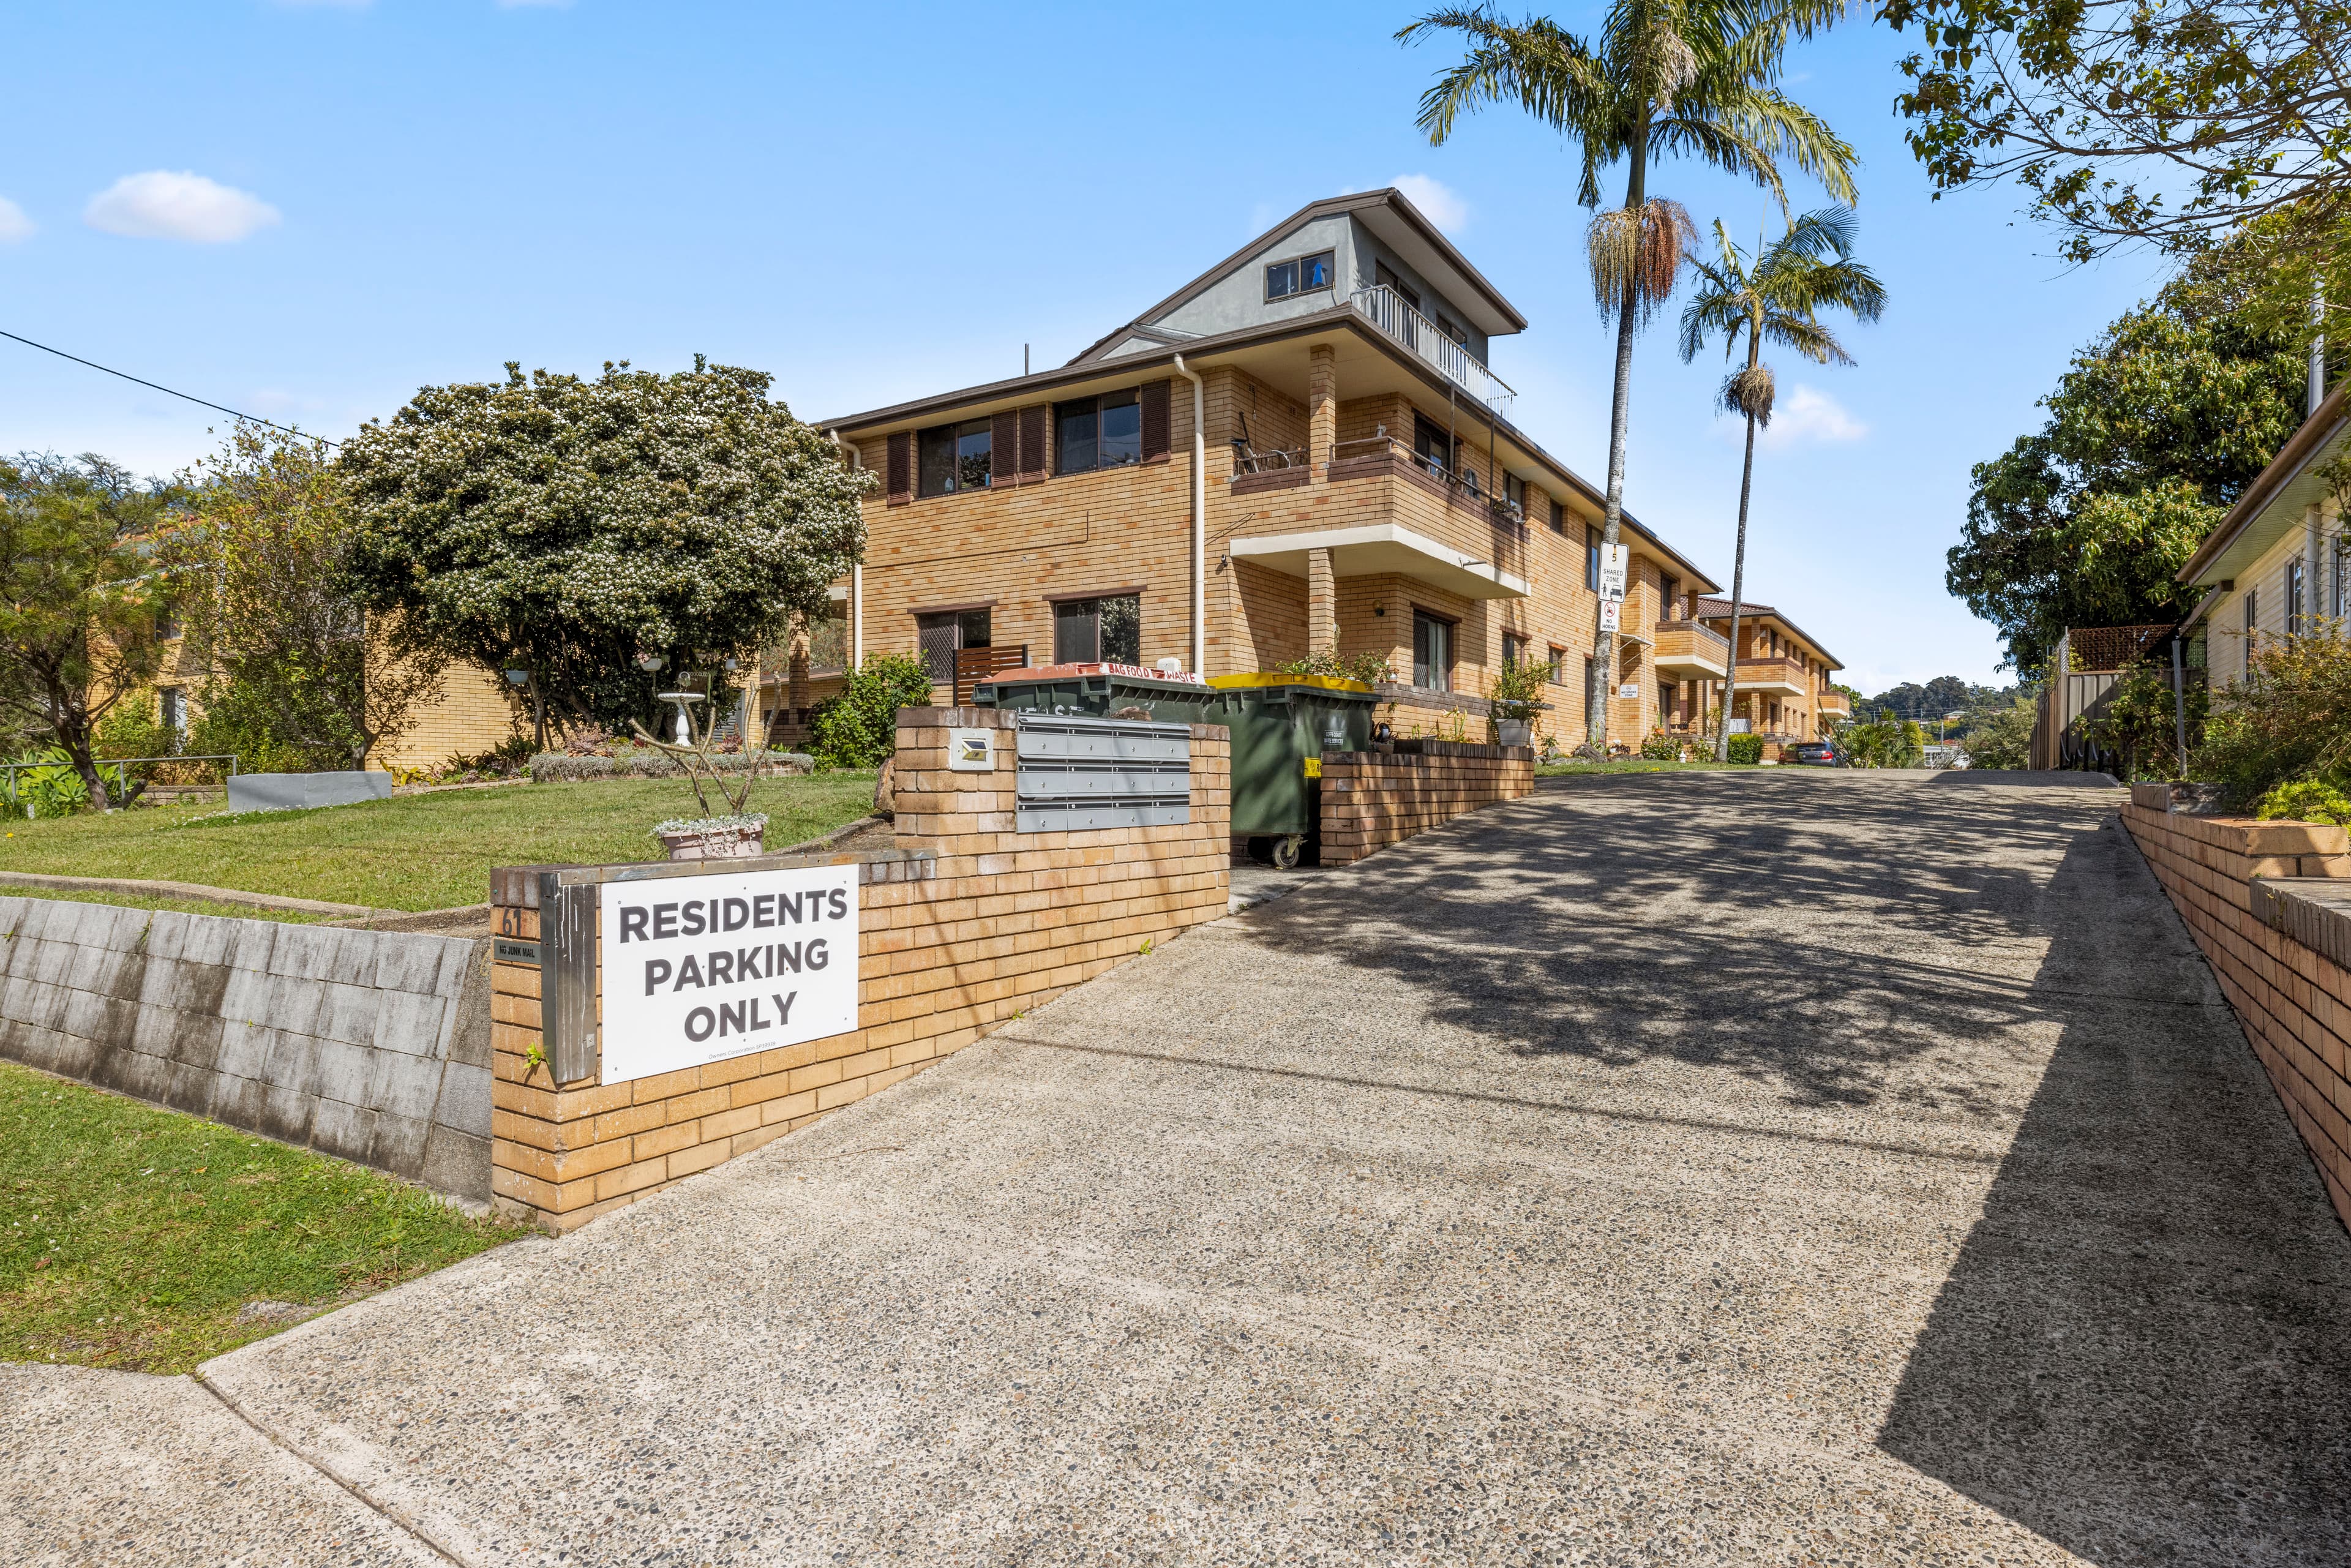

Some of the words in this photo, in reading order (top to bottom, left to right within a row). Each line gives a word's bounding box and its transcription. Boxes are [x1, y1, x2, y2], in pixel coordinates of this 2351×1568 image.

[1612, 553, 1617, 562] 5
[1109, 663, 1125, 674] BAG
[1166, 670, 1196, 683] WASTE
[502, 909, 522, 937] 61
[620, 888, 847, 943] RESIDENTS
[499, 945, 507, 955] NO
[508, 945, 522, 956] JUNK
[522, 947, 535, 958] MAIL
[645, 938, 828, 997] PARKING
[684, 991, 798, 1042] ONLY
[727, 1046, 756, 1056] Corporation
[756, 1041, 776, 1050] SP39939
